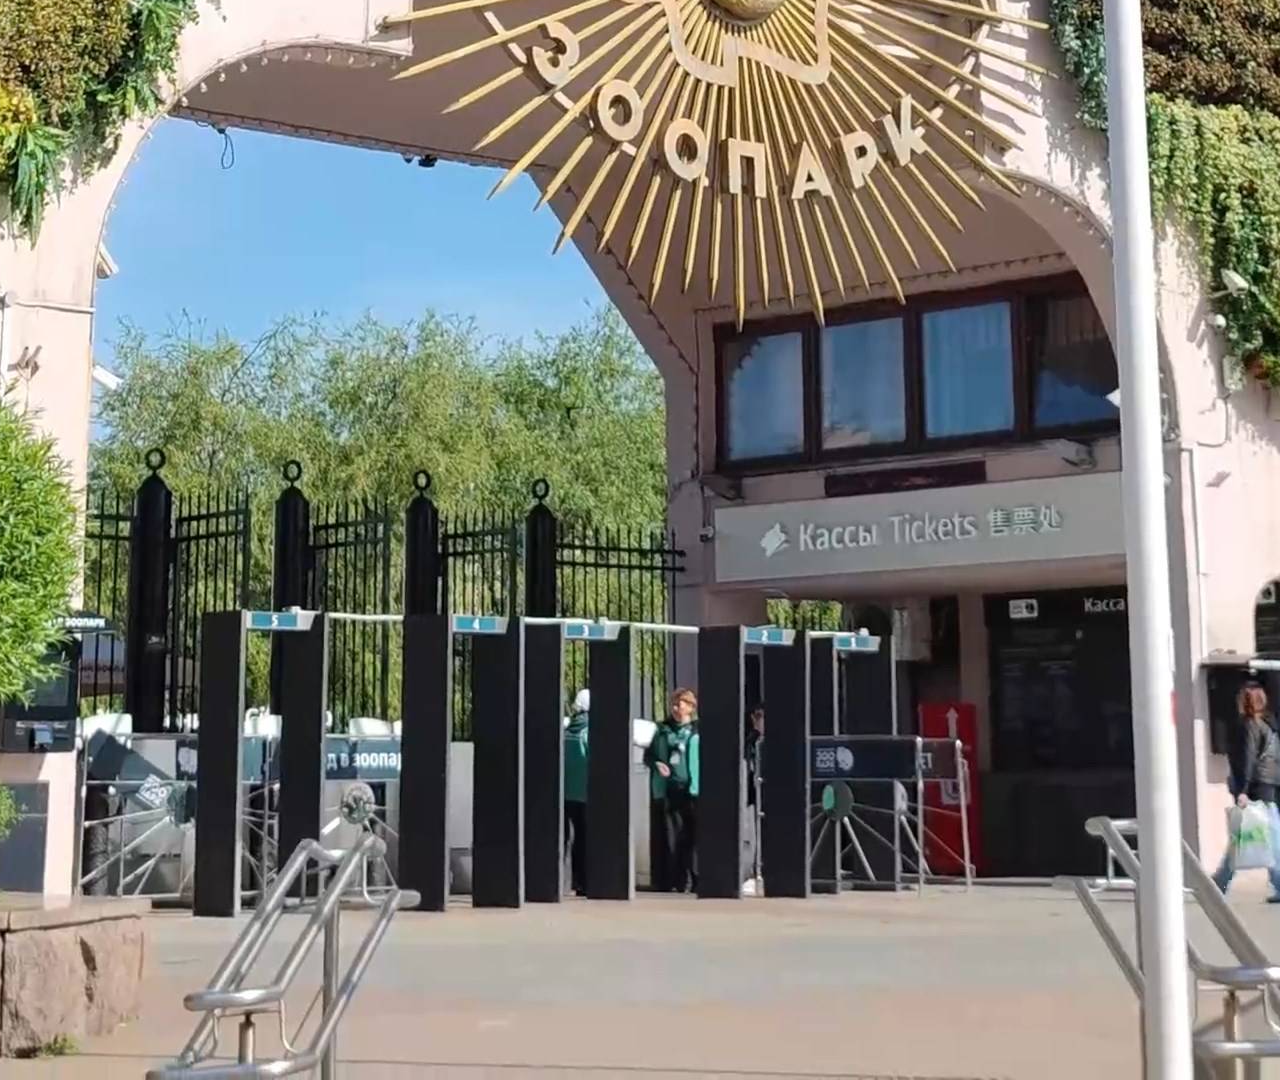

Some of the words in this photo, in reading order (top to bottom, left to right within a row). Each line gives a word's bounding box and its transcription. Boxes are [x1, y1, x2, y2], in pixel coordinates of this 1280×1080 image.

[528, 20, 927, 200] ЗООПАРК
[799, 523, 876, 552] Кассы
[888, 512, 977, 545] Tickets
[987, 504, 1062, 537] 售票处
[1083, 597, 1125, 613] Касса
[271, 614, 279, 627] 5
[472, 618, 480, 630] 4
[761, 630, 769, 642] 2
[850, 637, 857, 648] 1
